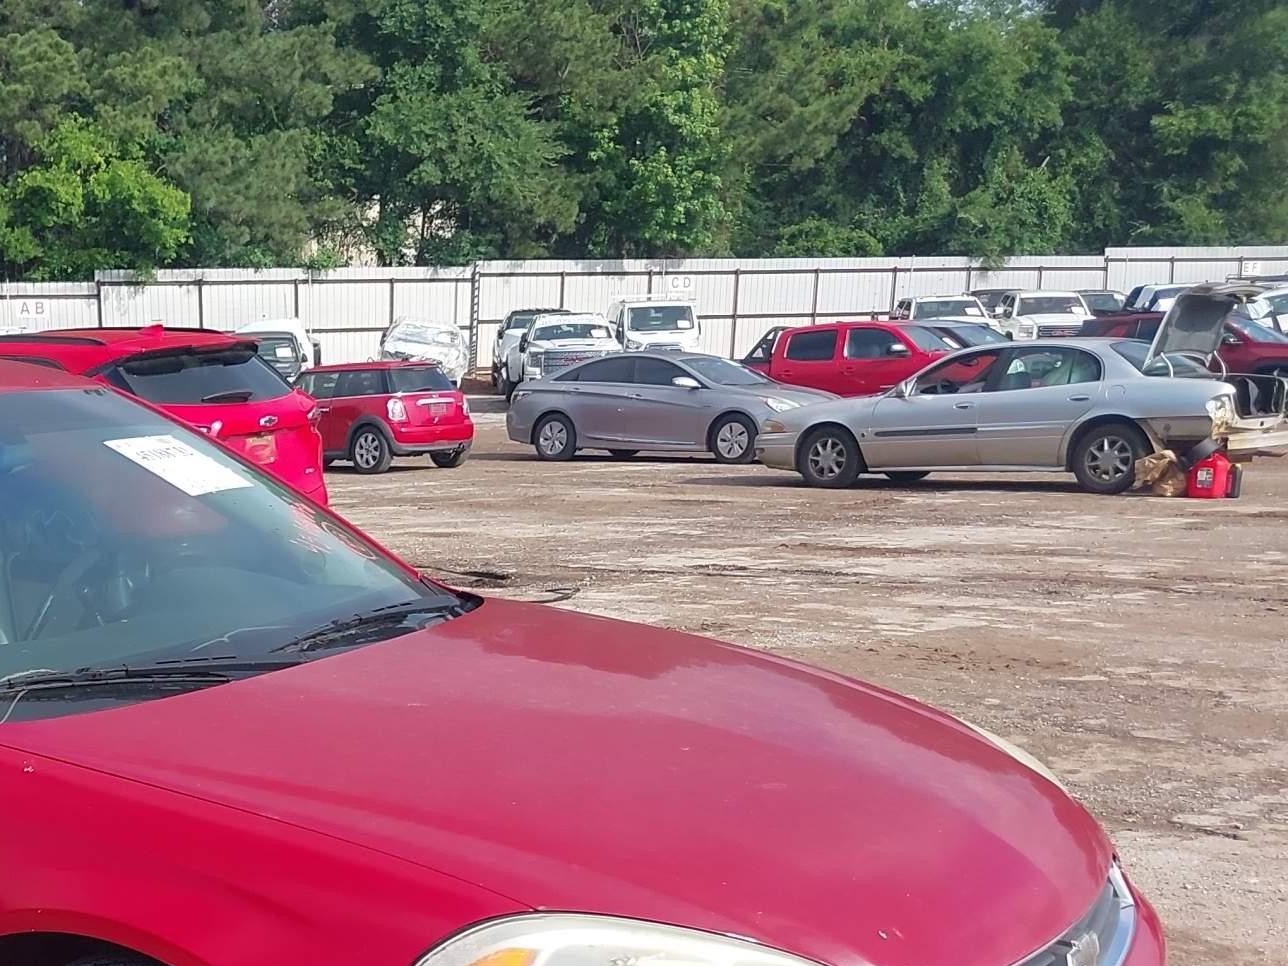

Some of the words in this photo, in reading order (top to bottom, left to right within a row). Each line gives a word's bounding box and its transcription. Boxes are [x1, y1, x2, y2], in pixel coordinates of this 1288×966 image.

[671, 276, 680, 289] C
[682, 276, 691, 289] D
[20, 301, 31, 315] A
[35, 301, 45, 315] B
